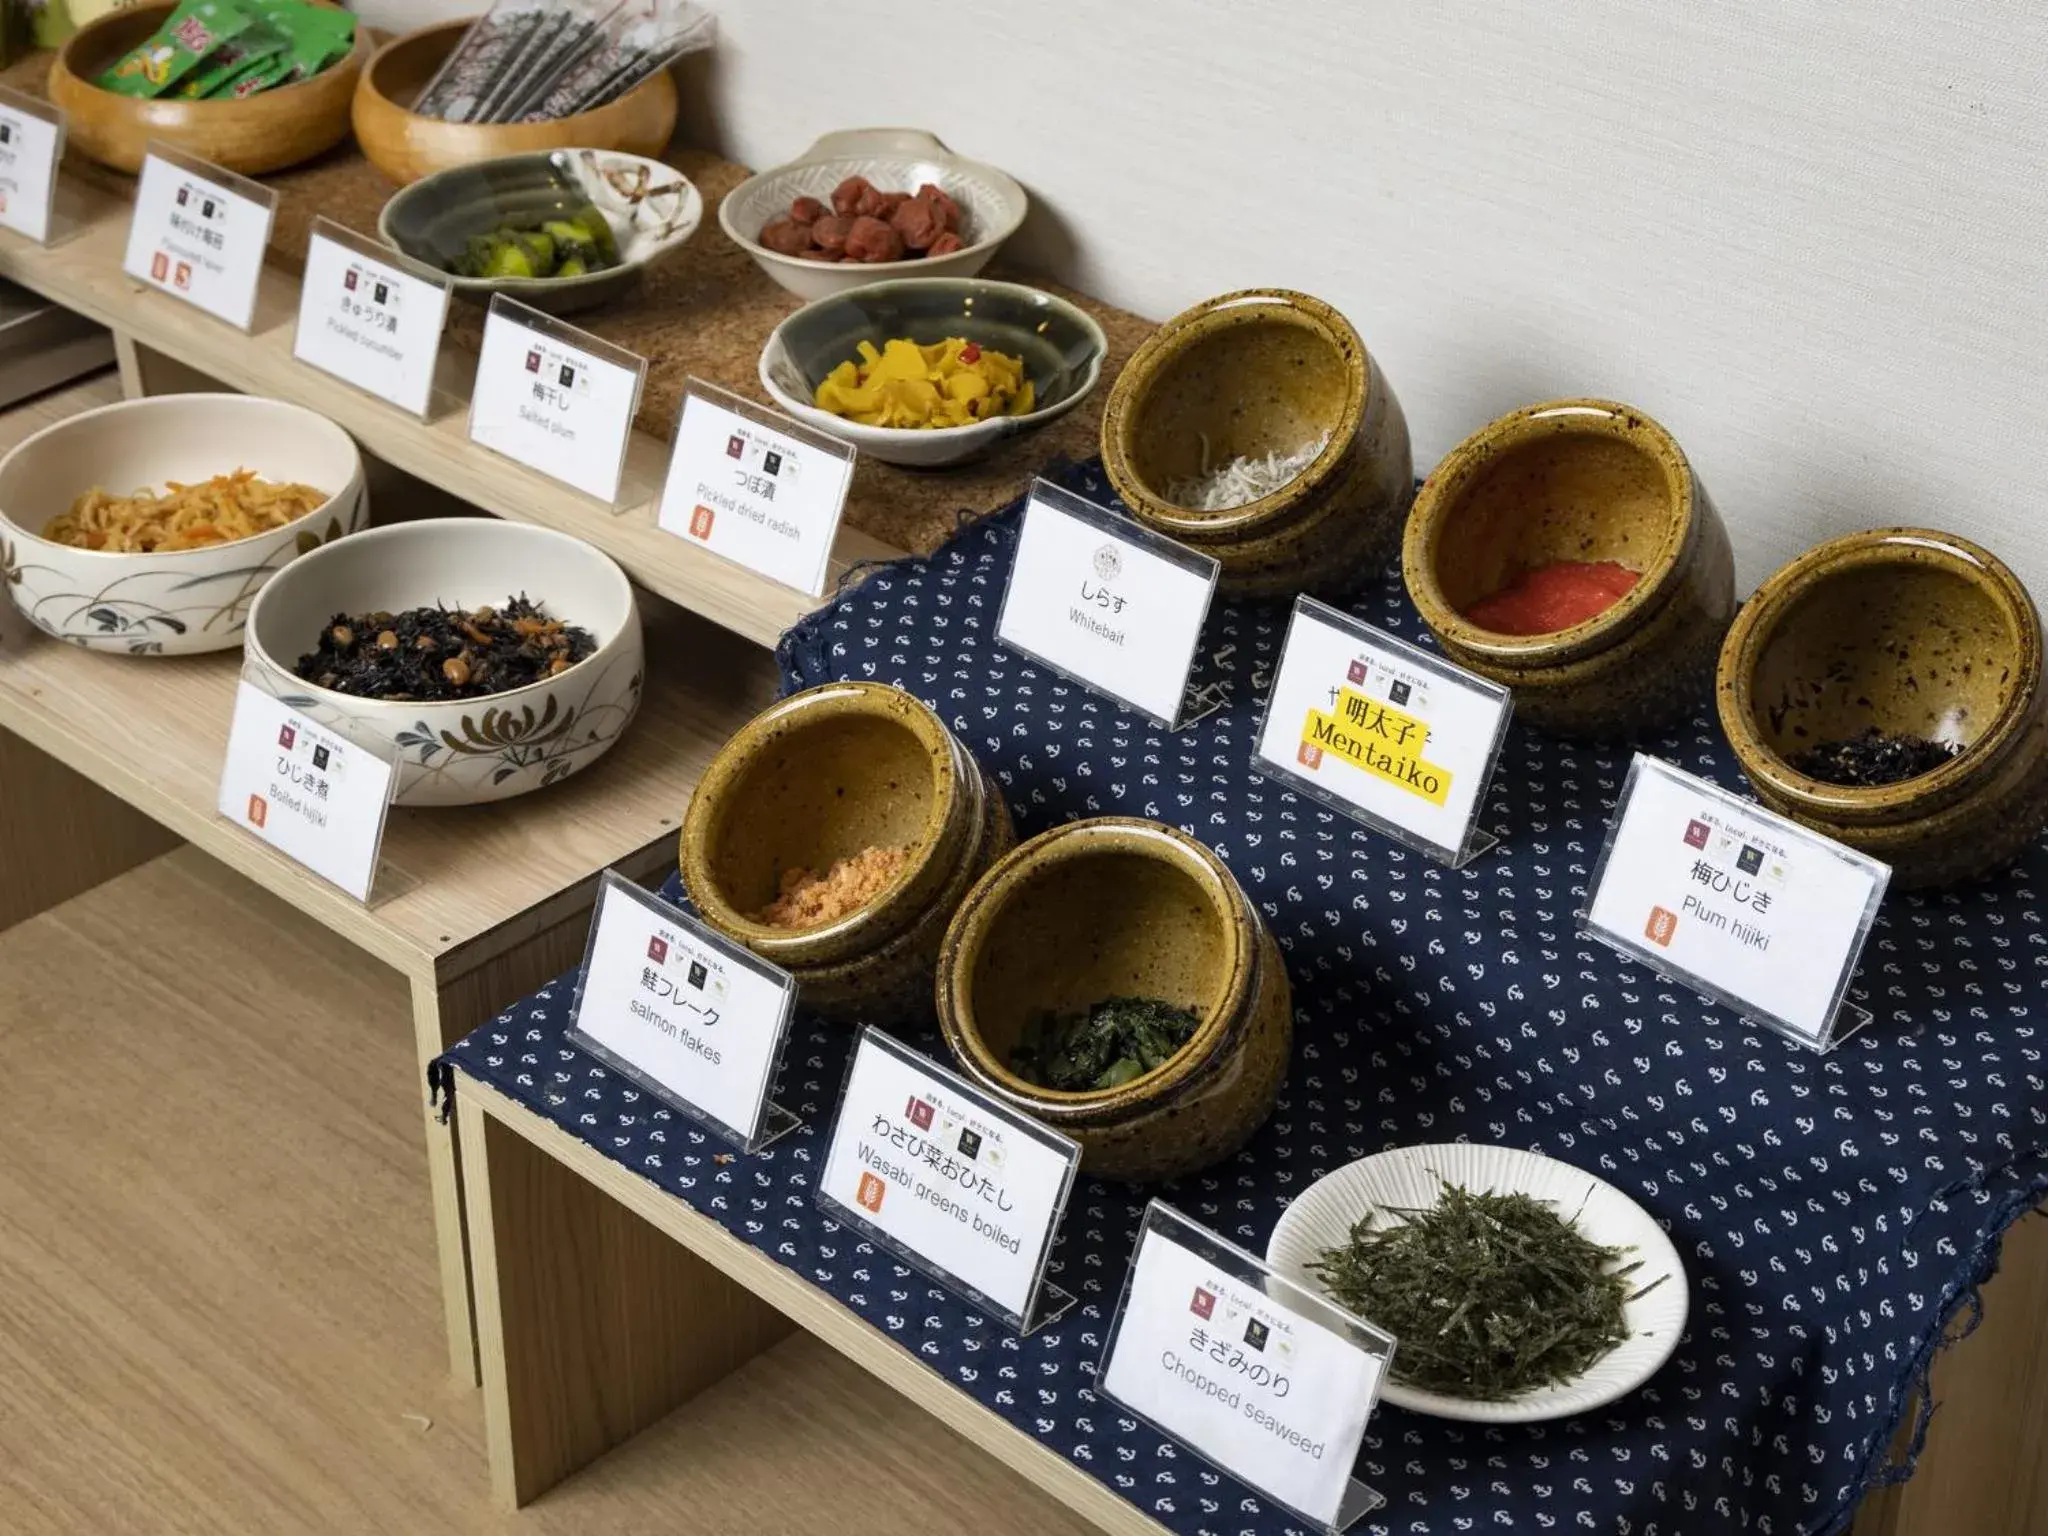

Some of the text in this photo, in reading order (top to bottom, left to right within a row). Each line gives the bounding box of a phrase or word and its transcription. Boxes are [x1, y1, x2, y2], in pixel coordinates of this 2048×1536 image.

[326, 316, 359, 343] Pickled
[532, 382, 570, 411] 梅干し
[696, 483, 800, 541] Pickled dried radish
[734, 470, 776, 503] つぼ漬
[1081, 581, 1128, 614] しらす
[1069, 607, 1125, 646] Whitebait
[1346, 695, 1416, 746] 明太子
[276, 756, 329, 801] ひじき煮
[1312, 718, 1439, 794] Mentaiko
[269, 783, 327, 829] Boiled hijiki
[1690, 858, 1773, 915] 梅ひじき
[1682, 895, 1770, 952] Plum hijiki
[640, 967, 720, 1027] 鮭フレーク
[630, 998, 722, 1066] salmon flakes
[871, 1113, 1013, 1212] わさび菜おひたし
[858, 1142, 1021, 1255] Wasabi greens boiled
[1188, 1328, 1290, 1398] きざみのり
[1161, 1350, 1326, 1460] Chopped seaweed
